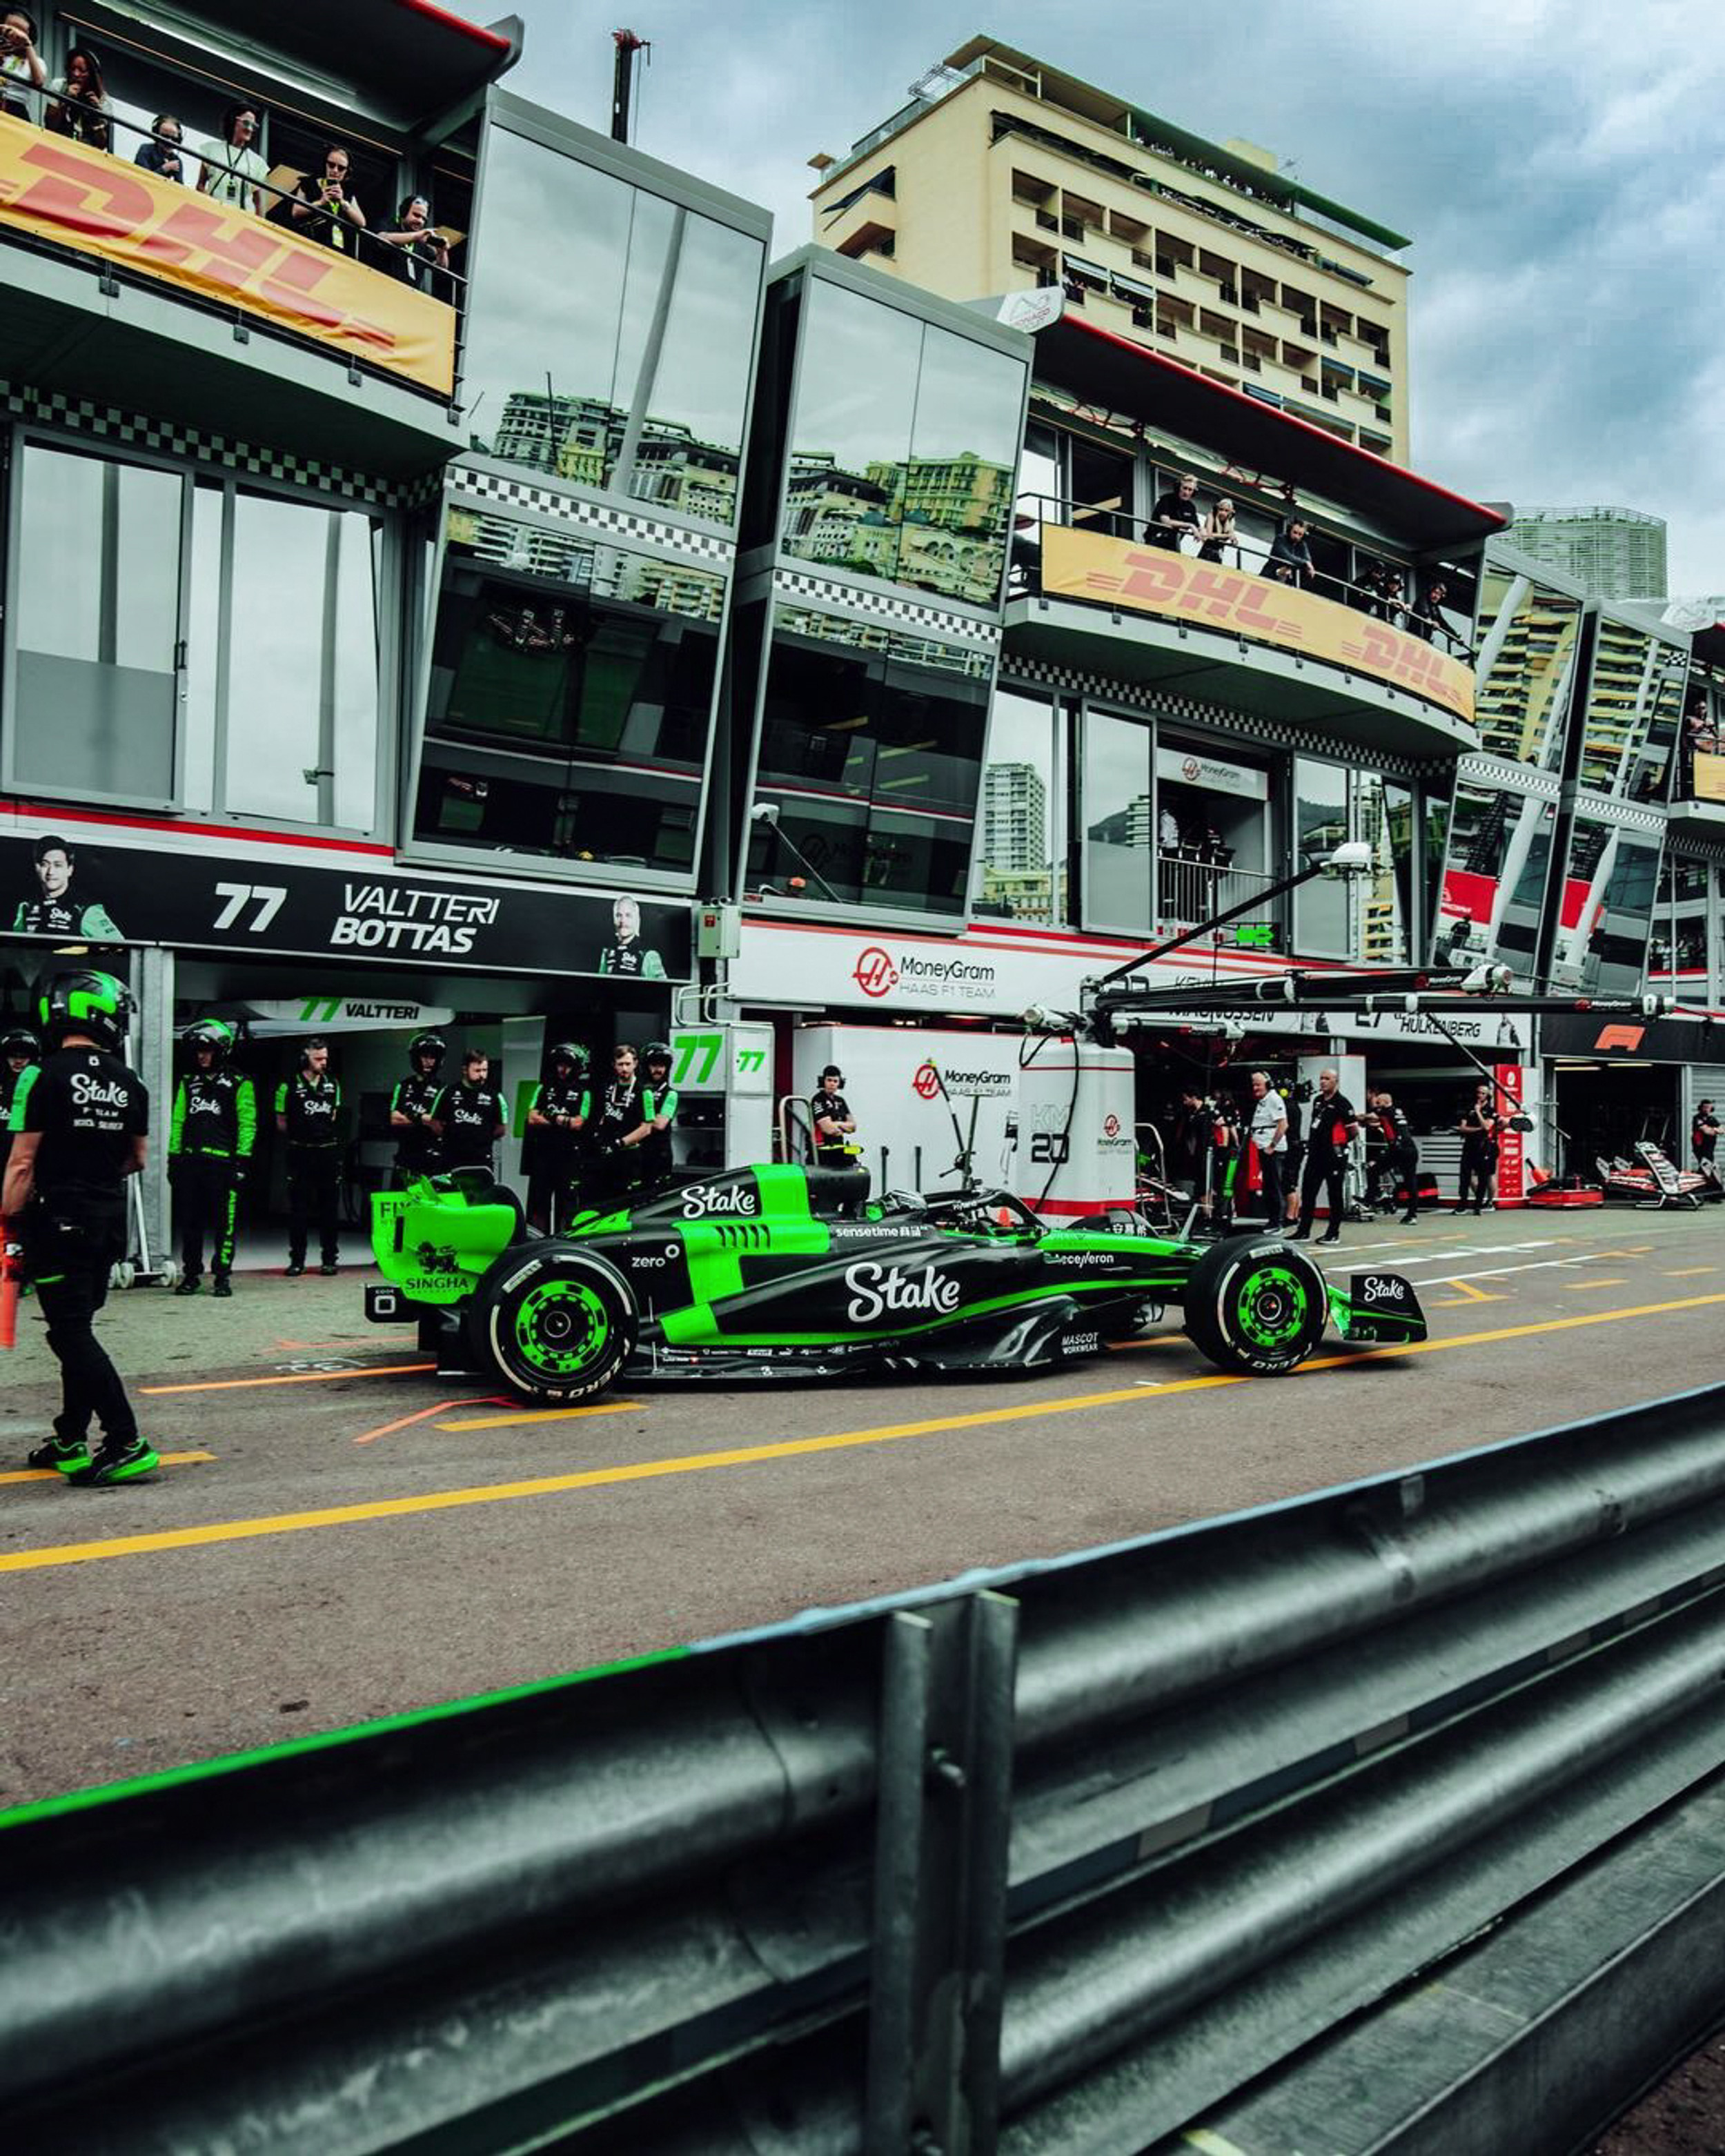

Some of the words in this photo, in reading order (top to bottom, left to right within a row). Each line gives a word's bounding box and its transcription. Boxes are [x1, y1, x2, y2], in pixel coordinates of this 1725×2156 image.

[8, 143, 343, 327] DHL
[1123, 553, 1279, 629] DHL
[1362, 624, 1451, 695] DHL
[213, 882, 288, 933] 77
[345, 884, 500, 924] VALTTERI
[330, 916, 477, 953] BOTTAS
[900, 956, 994, 981] MoneyGram
[900, 985, 938, 996] HAAS
[959, 987, 994, 998] TEAM
[299, 996, 344, 1022] 77
[346, 1003, 419, 1020] VALTTERI
[673, 1035, 722, 1083] 77
[739, 1051, 765, 1072] 77
[70, 1073, 128, 1107] Stake
[945, 1069, 1011, 1086] MoneyGram
[189, 1097, 221, 1115] Stake
[304, 1100, 332, 1115] Stake
[1031, 1133, 1070, 1163] 20
[681, 1185, 756, 1219] Stake
[837, 1226, 898, 1237] sensetime
[406, 1278, 469, 1289] SINGHA
[845, 1262, 960, 1323] Stake
[1363, 1276, 1405, 1302] Stake
[1061, 1332, 1099, 1345] MASCOT
